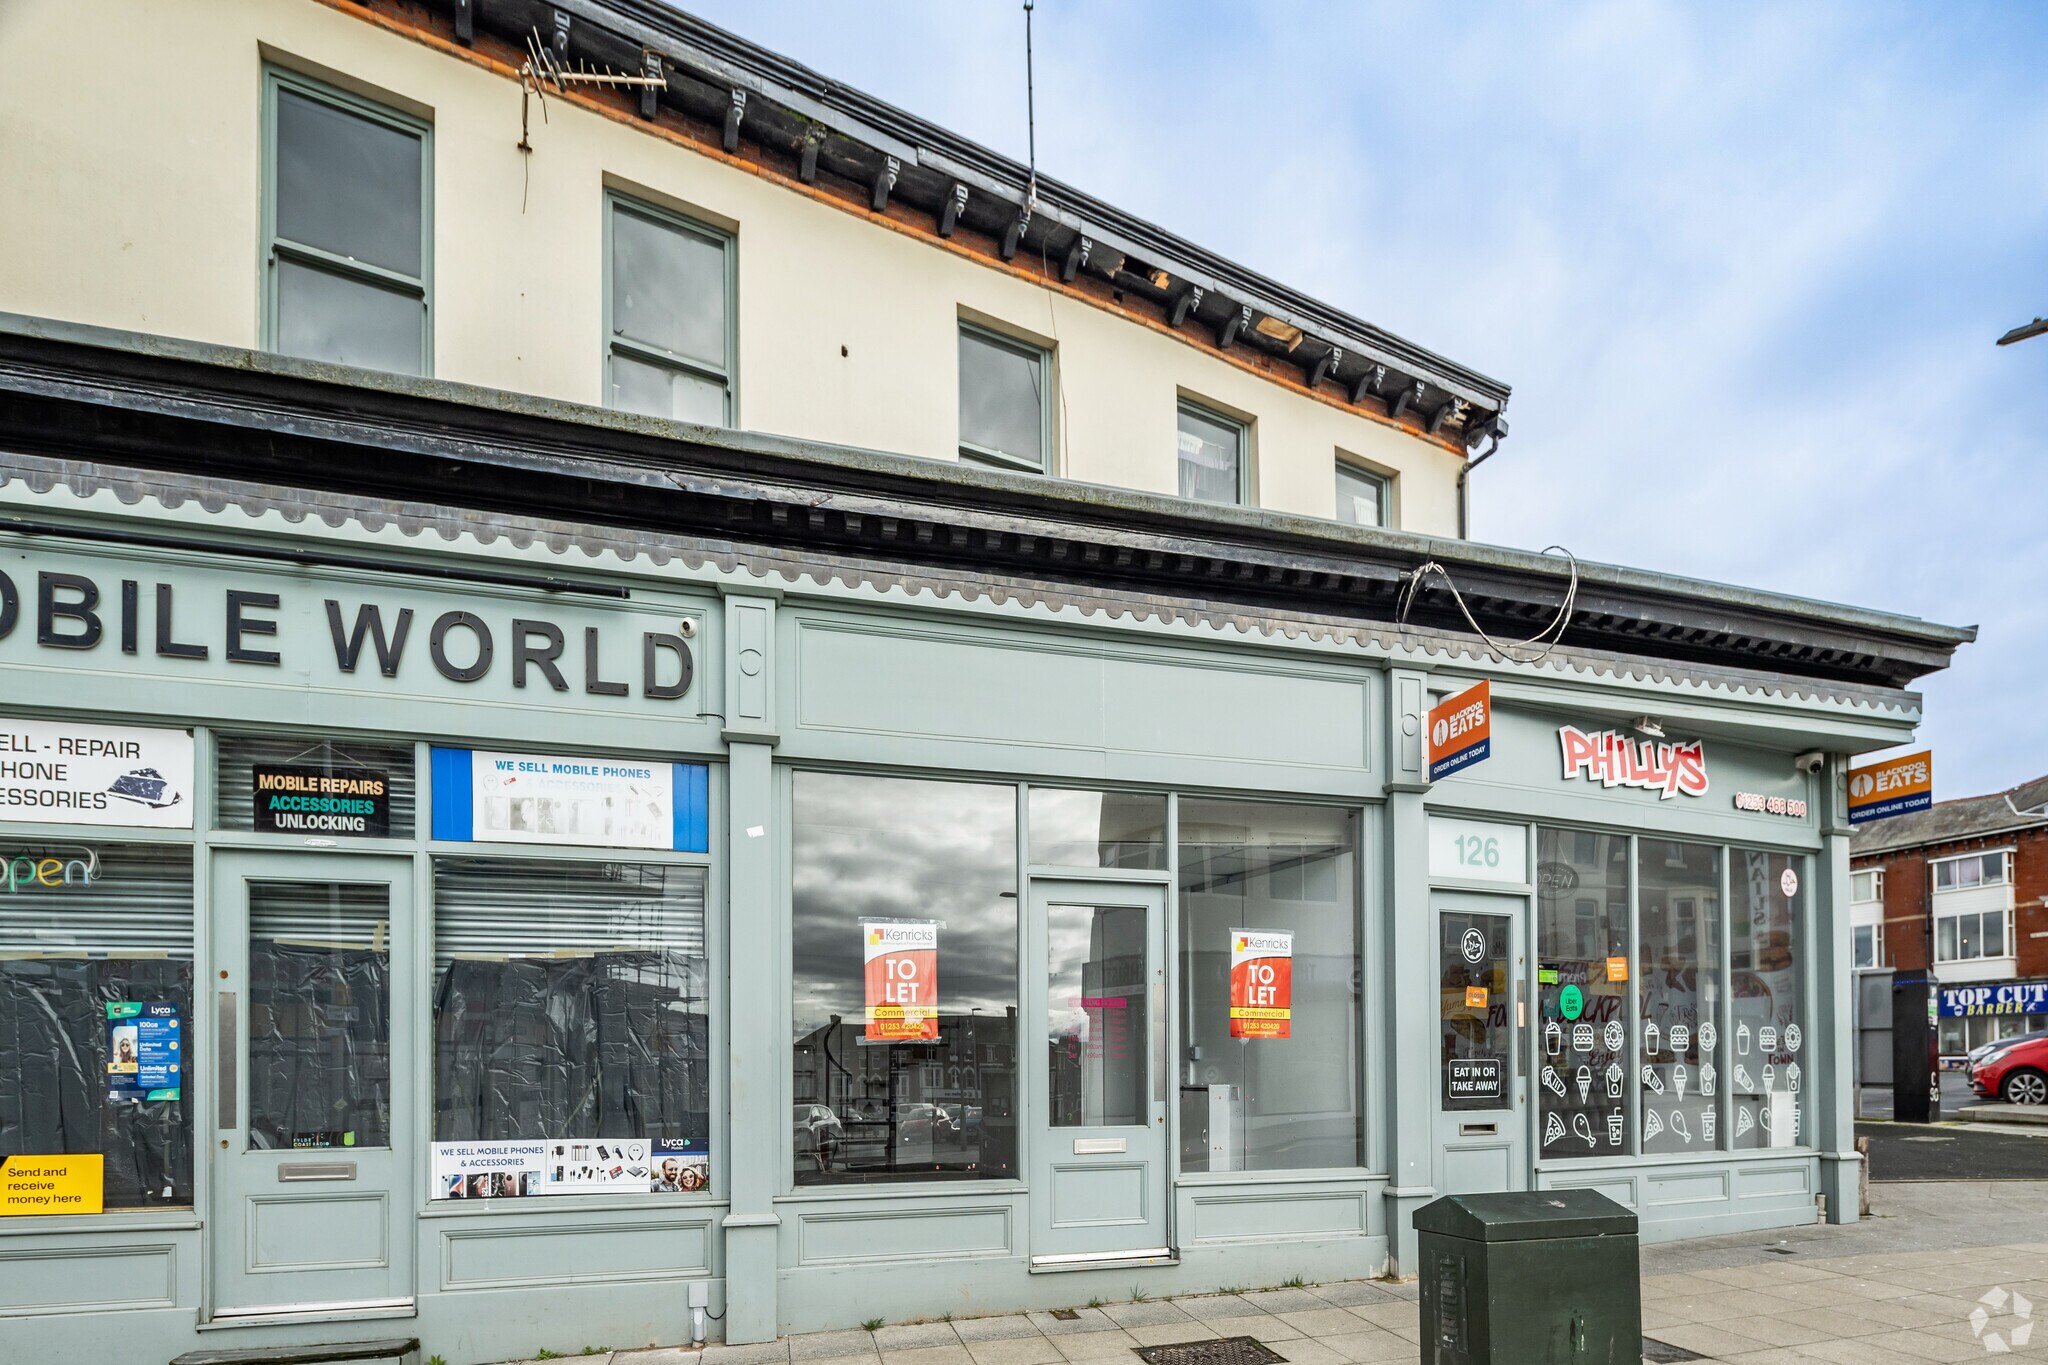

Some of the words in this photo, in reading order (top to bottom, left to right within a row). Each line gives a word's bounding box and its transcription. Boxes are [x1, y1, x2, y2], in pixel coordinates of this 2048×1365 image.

[324, 599, 694, 700] WORLD
[1450, 701, 1484, 724] BLACKPOOL
[1450, 708, 1485, 739] EATS
[58, 738, 140, 759] REPAIR
[1434, 761, 1450, 774] ORDER
[1450, 754, 1468, 767] ONLINE
[1469, 745, 1486, 758] TODAY
[1559, 725, 1709, 800] PHILLYS
[495, 760, 514, 771] WE
[518, 762, 549, 773] SELL
[552, 764, 599, 776] MOBILE
[603, 767, 651, 779] PHONES
[1876, 761, 1927, 778] BLACKPOOL
[259, 774, 318, 792] MOBILE
[320, 778, 384, 795] REPAIRS
[1876, 768, 1928, 792] EATS
[269, 795, 375, 815] ACCESSORIES
[1736, 792, 1765, 811] 01253
[1767, 796, 1786, 814] 468
[1787, 799, 1806, 817] 500
[1851, 809, 1875, 819] ORDER
[1877, 803, 1903, 813] ONLINE
[1905, 797, 1930, 808] TODAY
[275, 813, 365, 832] UNLOCKING
[1454, 834, 1500, 867] 126
[885, 928, 933, 941] Kenricks
[1249, 936, 1289, 949] Kenricks
[885, 959, 917, 980] TO
[1248, 965, 1275, 985] TO
[885, 982, 919, 1003] LET
[1248, 986, 1277, 1005] LET
[1943, 987, 1992, 1007] TOP
[1996, 983, 2048, 1004] CUT
[151, 1006, 171, 1015] Lyca
[874, 1008, 930, 1017] Commercial
[1238, 1009, 1285, 1018] Commercial
[1967, 1002, 2023, 1016] BARBER
[1454, 1067, 1470, 1077] EAT
[1471, 1067, 1481, 1077] IN
[1483, 1067, 1496, 1077] OR
[1452, 1081, 1474, 1091] TAKE
[1475, 1081, 1498, 1091] AWAY
[456, 1148, 475, 1156] SELL
[476, 1147, 509, 1155] MOBILE
[510, 1146, 544, 1154] PHONES
[661, 1138, 684, 1148] Lyca
[8, 1168, 41, 1177] Send
[43, 1167, 67, 1177] and
[460, 1159, 467, 1167] &
[469, 1158, 525, 1167] ACCESSORIES
[7, 1181, 55, 1190] receive
[7, 1196, 50, 1205] money
[53, 1194, 82, 1203] here
